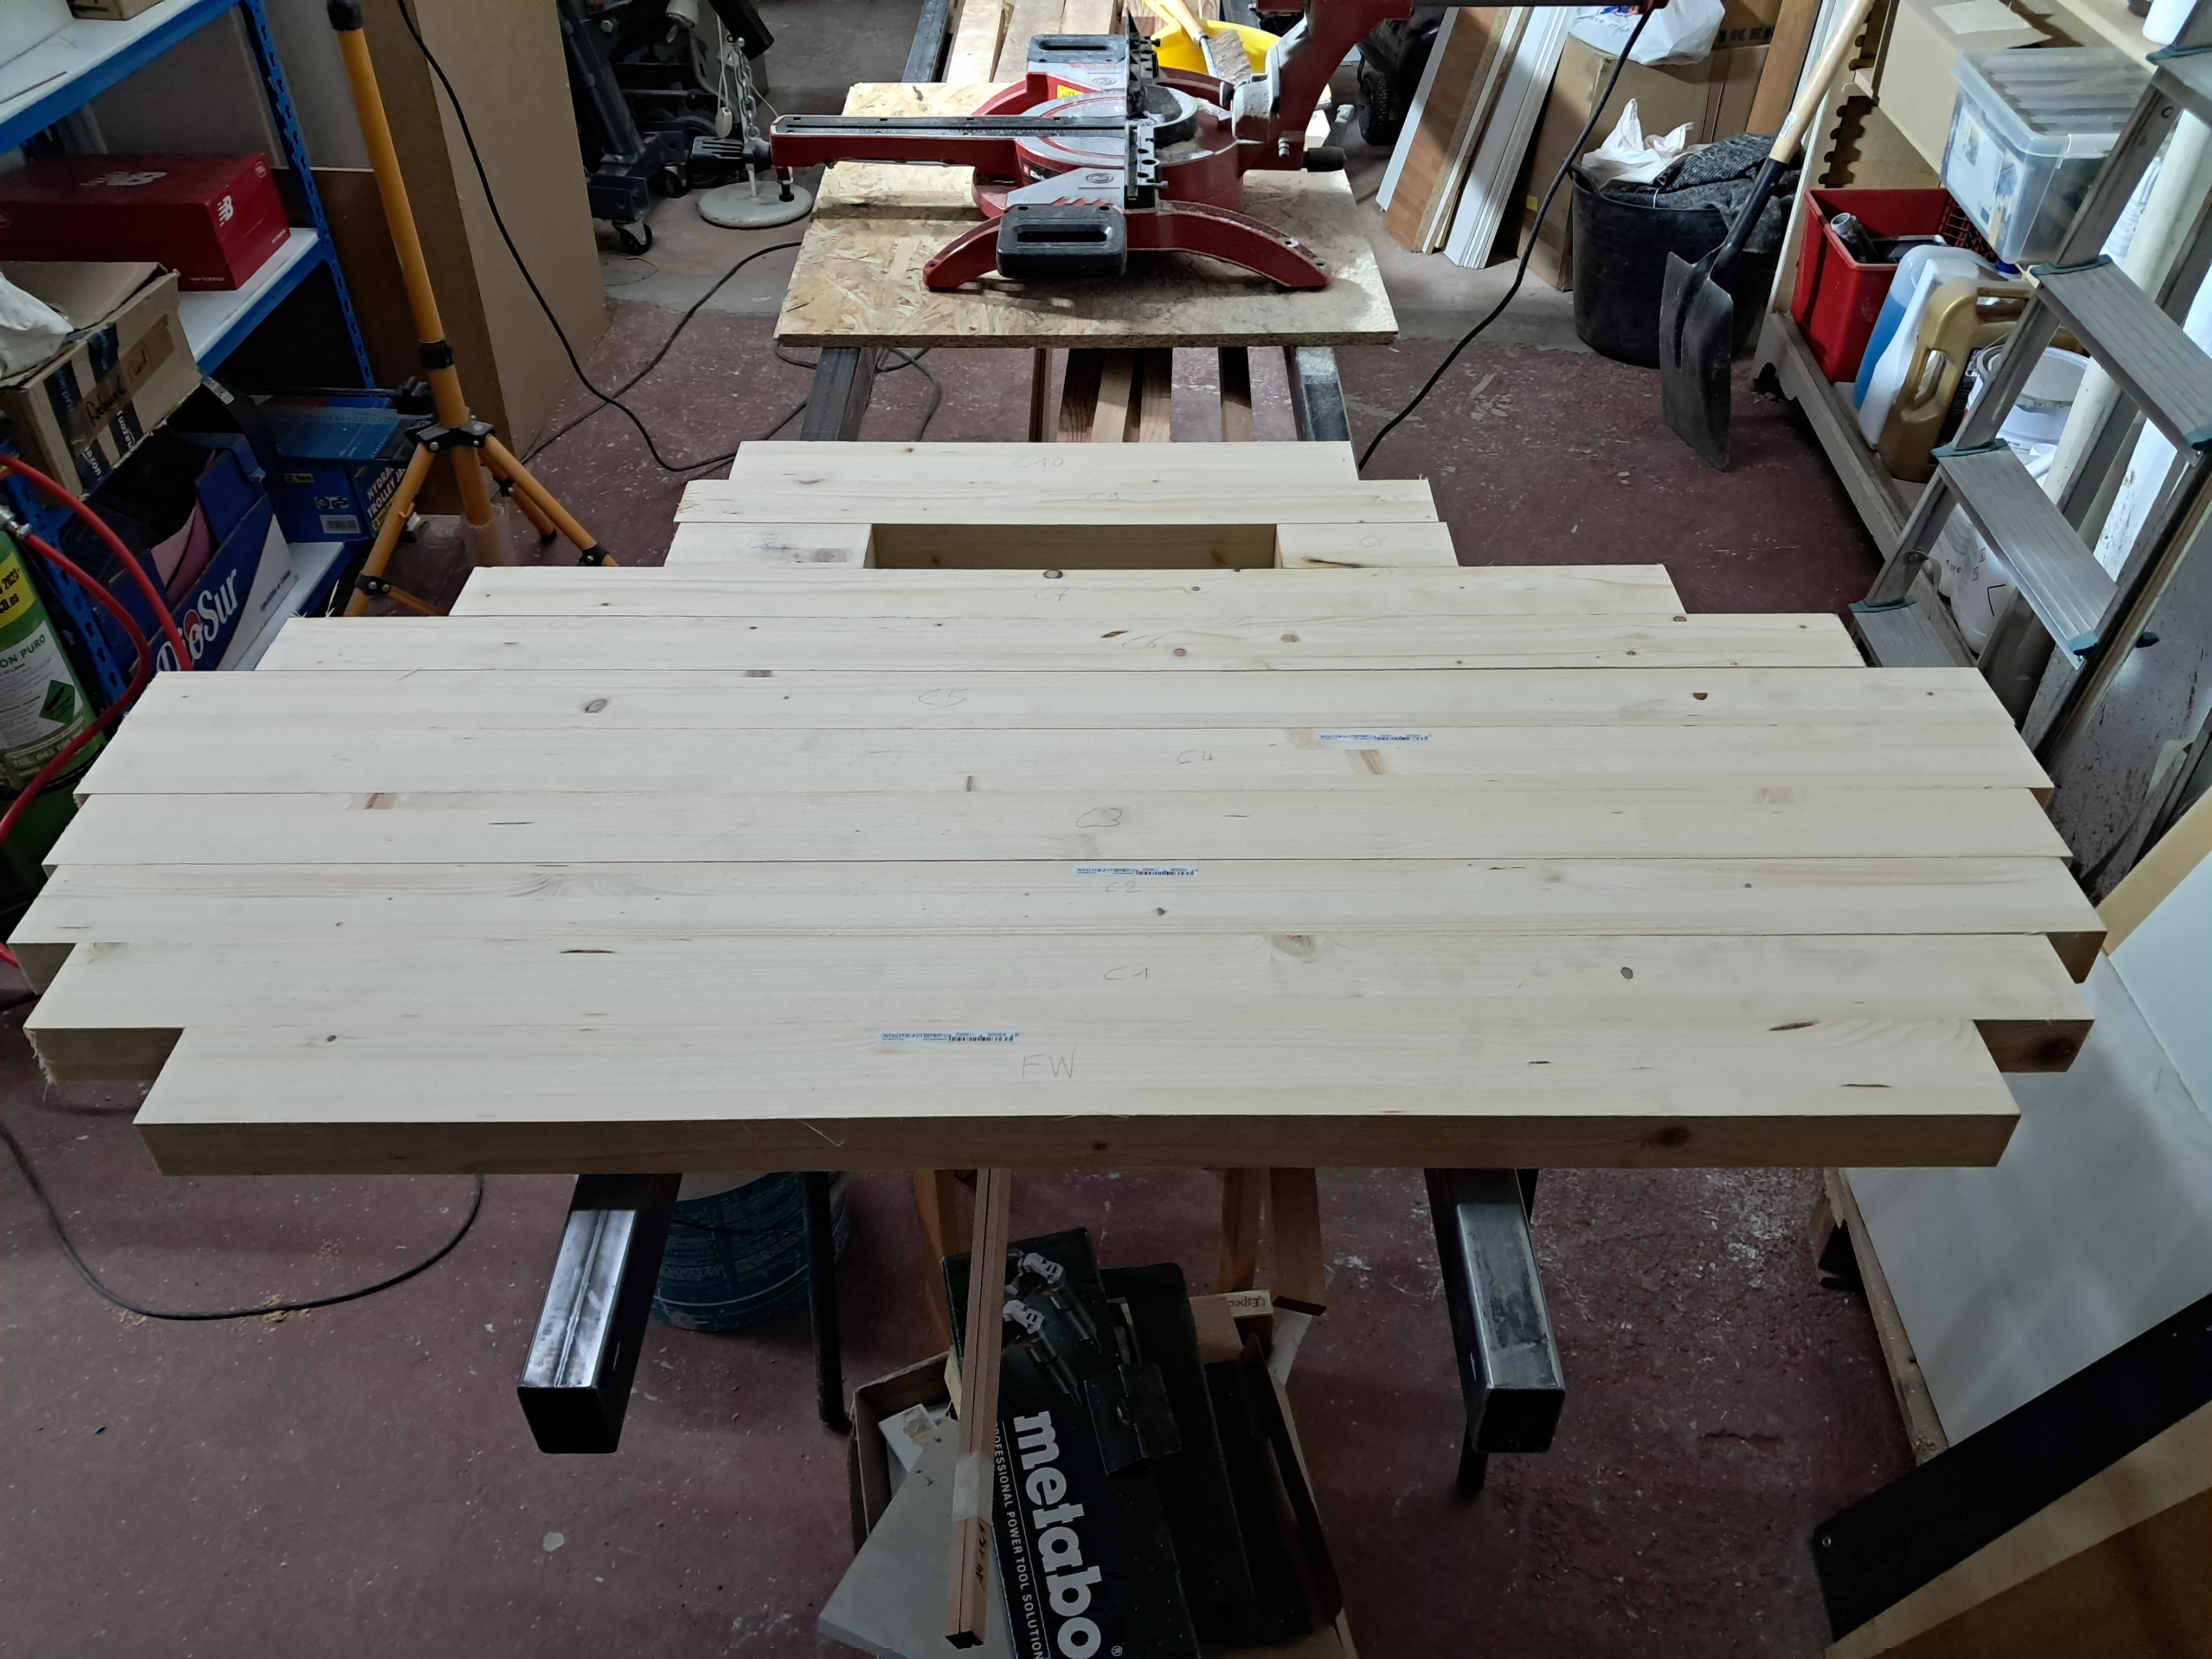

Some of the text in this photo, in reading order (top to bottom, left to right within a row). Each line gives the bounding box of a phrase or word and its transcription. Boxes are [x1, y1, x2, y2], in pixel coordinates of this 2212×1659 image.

[1014, 456, 1064, 468] C10
[366, 478, 396, 519] TROLLEY
[20, 634, 46, 659] PURO
[1104, 880, 1142, 893] C2
[1103, 966, 1149, 980] C1
[1022, 1047, 1077, 1079] FW
[994, 1420, 1044, 1659] OFESSIONAL POWER TOOL SOLUTION
[1013, 1410, 1103, 1659] metabo
